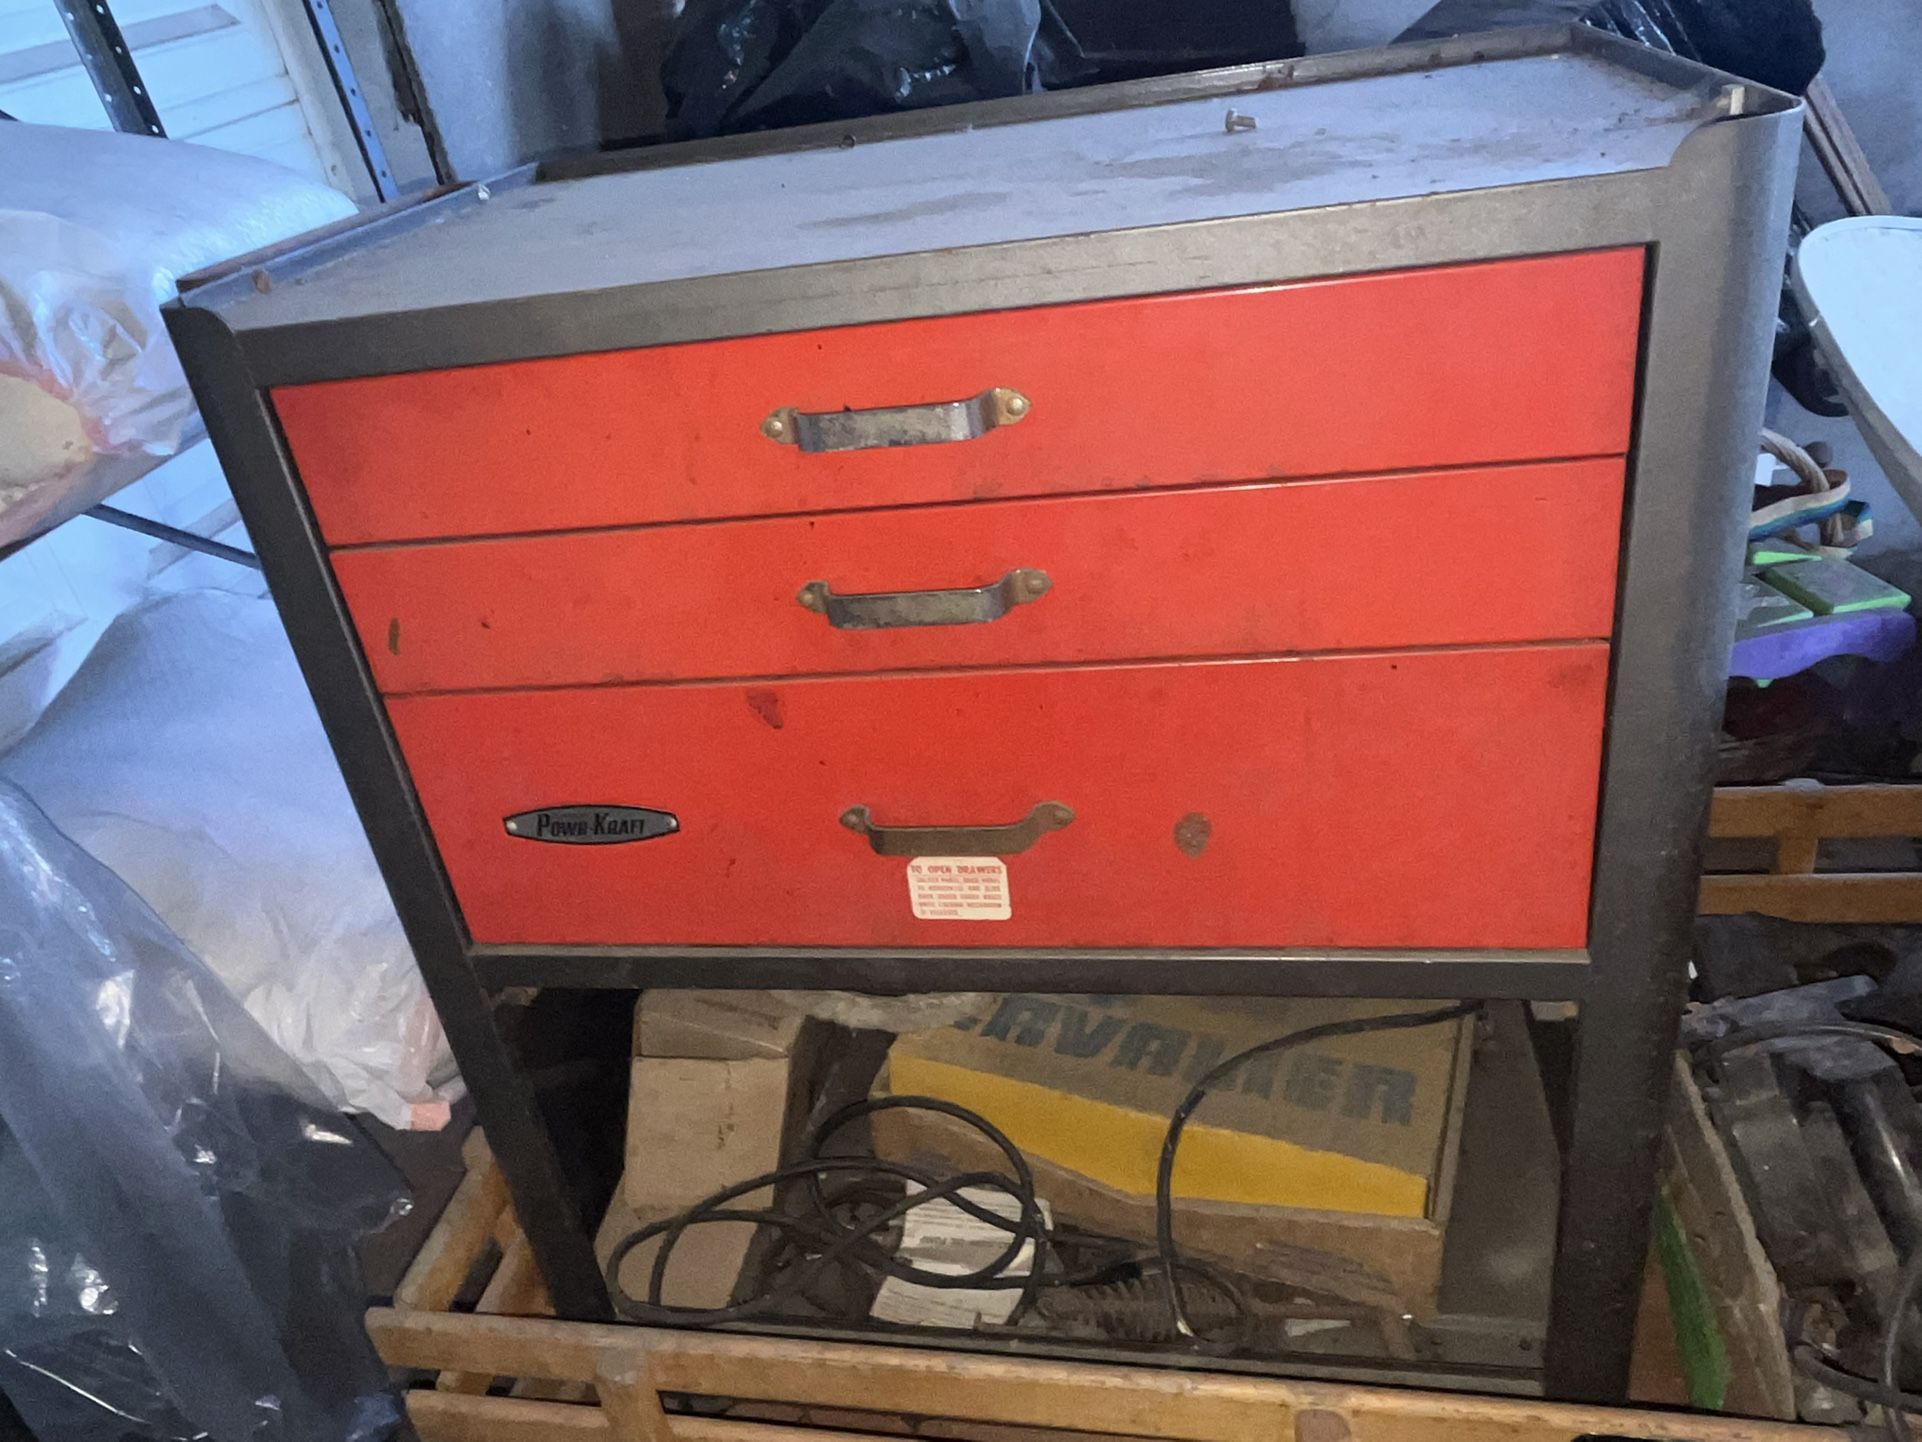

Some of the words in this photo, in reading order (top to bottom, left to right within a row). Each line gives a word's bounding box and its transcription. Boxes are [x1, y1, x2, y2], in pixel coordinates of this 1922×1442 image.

[910, 865, 922, 874] TO
[927, 865, 951, 874] OPEN
[956, 865, 1002, 874] DRAWERS
[953, 997, 1418, 1126] AVALIER
